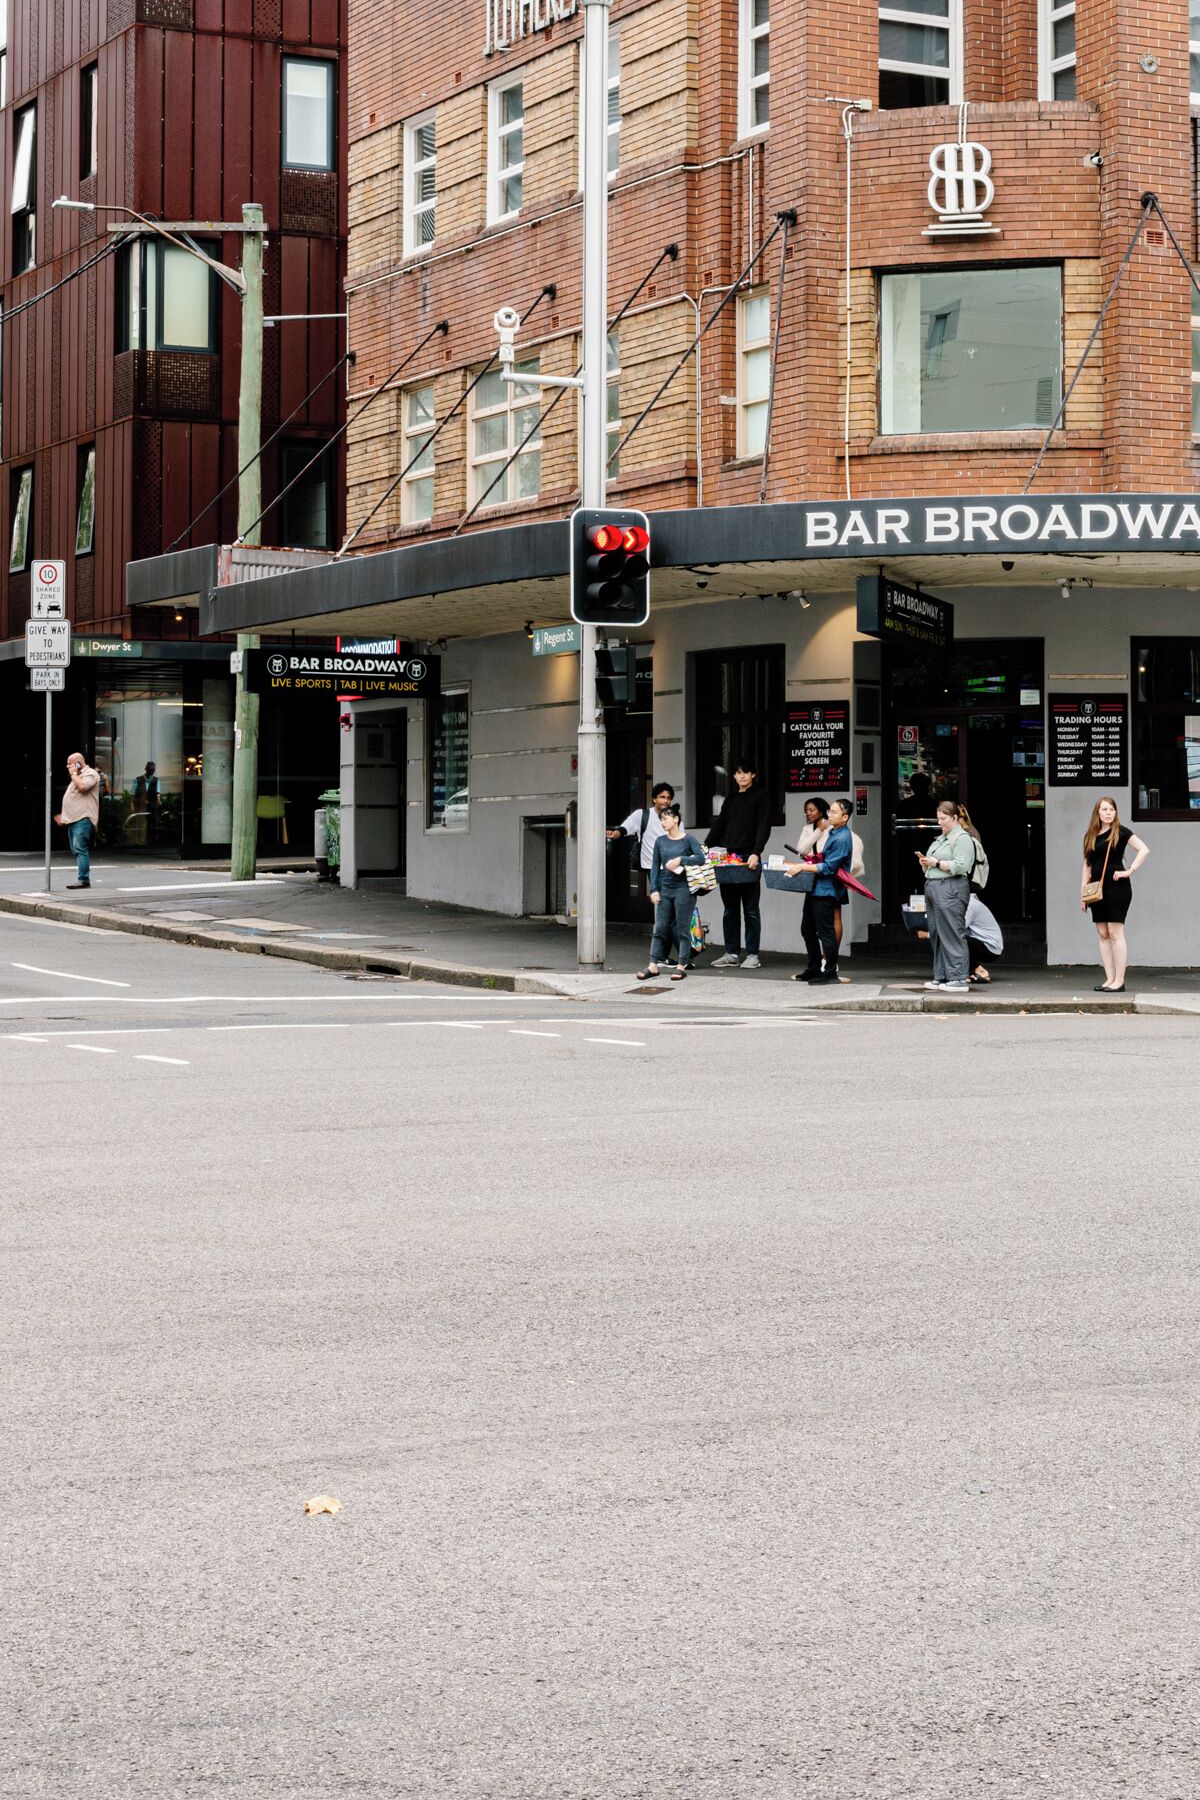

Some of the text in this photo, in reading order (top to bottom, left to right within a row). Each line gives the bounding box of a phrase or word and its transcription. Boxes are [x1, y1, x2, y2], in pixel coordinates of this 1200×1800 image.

[805, 508, 911, 547] BAR
[43, 569, 54, 579] 10
[893, 590, 905, 609] BAR
[907, 595, 939, 620] BROADWAY
[29, 626, 66, 635] GIVE WAY
[543, 628, 574, 647] Regent St
[43, 639, 52, 648] TO
[92, 642, 132, 652] Dwyer St
[29, 652, 66, 661] PEDESTRIANS
[290, 656, 407, 673] BAR BROADWAY
[271, 678, 292, 688] LIVE
[295, 679, 332, 689] SPORTS
[340, 680, 357, 689] TAB
[366, 681, 385, 691] LIVE
[388, 682, 419, 692] MUSIC
[1054, 716, 1092, 724] TRADING
[826, 722, 844, 730] YOUR
[799, 732, 835, 740] FAVOURITE
[804, 740, 830, 748] SPORTS
[791, 749, 805, 757] LIVE
[818, 748, 830, 756] THE
[831, 748, 842, 756] BIG
[804, 757, 830, 765] SCREEN
